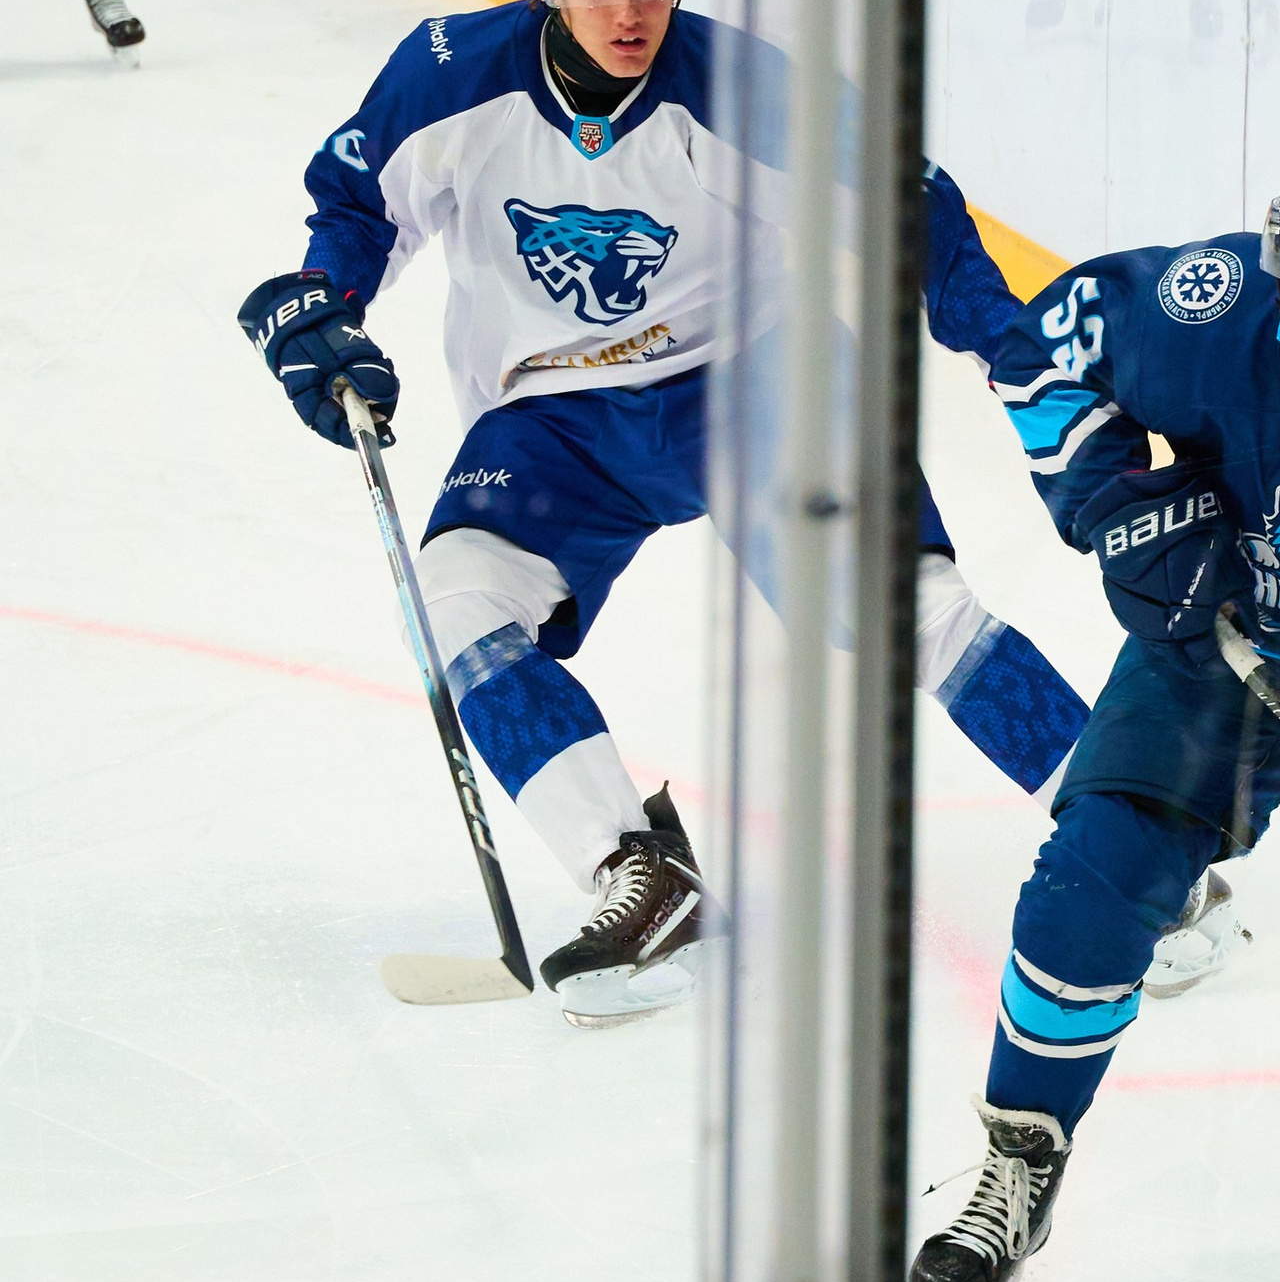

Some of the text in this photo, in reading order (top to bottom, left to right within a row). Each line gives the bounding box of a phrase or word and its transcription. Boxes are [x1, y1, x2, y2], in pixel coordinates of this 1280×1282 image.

[430, 23, 453, 65] Halyk
[1163, 295, 1189, 320] ОБЛАСТЬ
[1223, 282, 1238, 302] КЛУБ
[1195, 302, 1227, 320] СИБИРЬ
[1041, 276, 1104, 383] 53
[445, 468, 512, 493] Halyk
[1105, 491, 1223, 561] BAUE
[639, 891, 685, 945] TACKS
